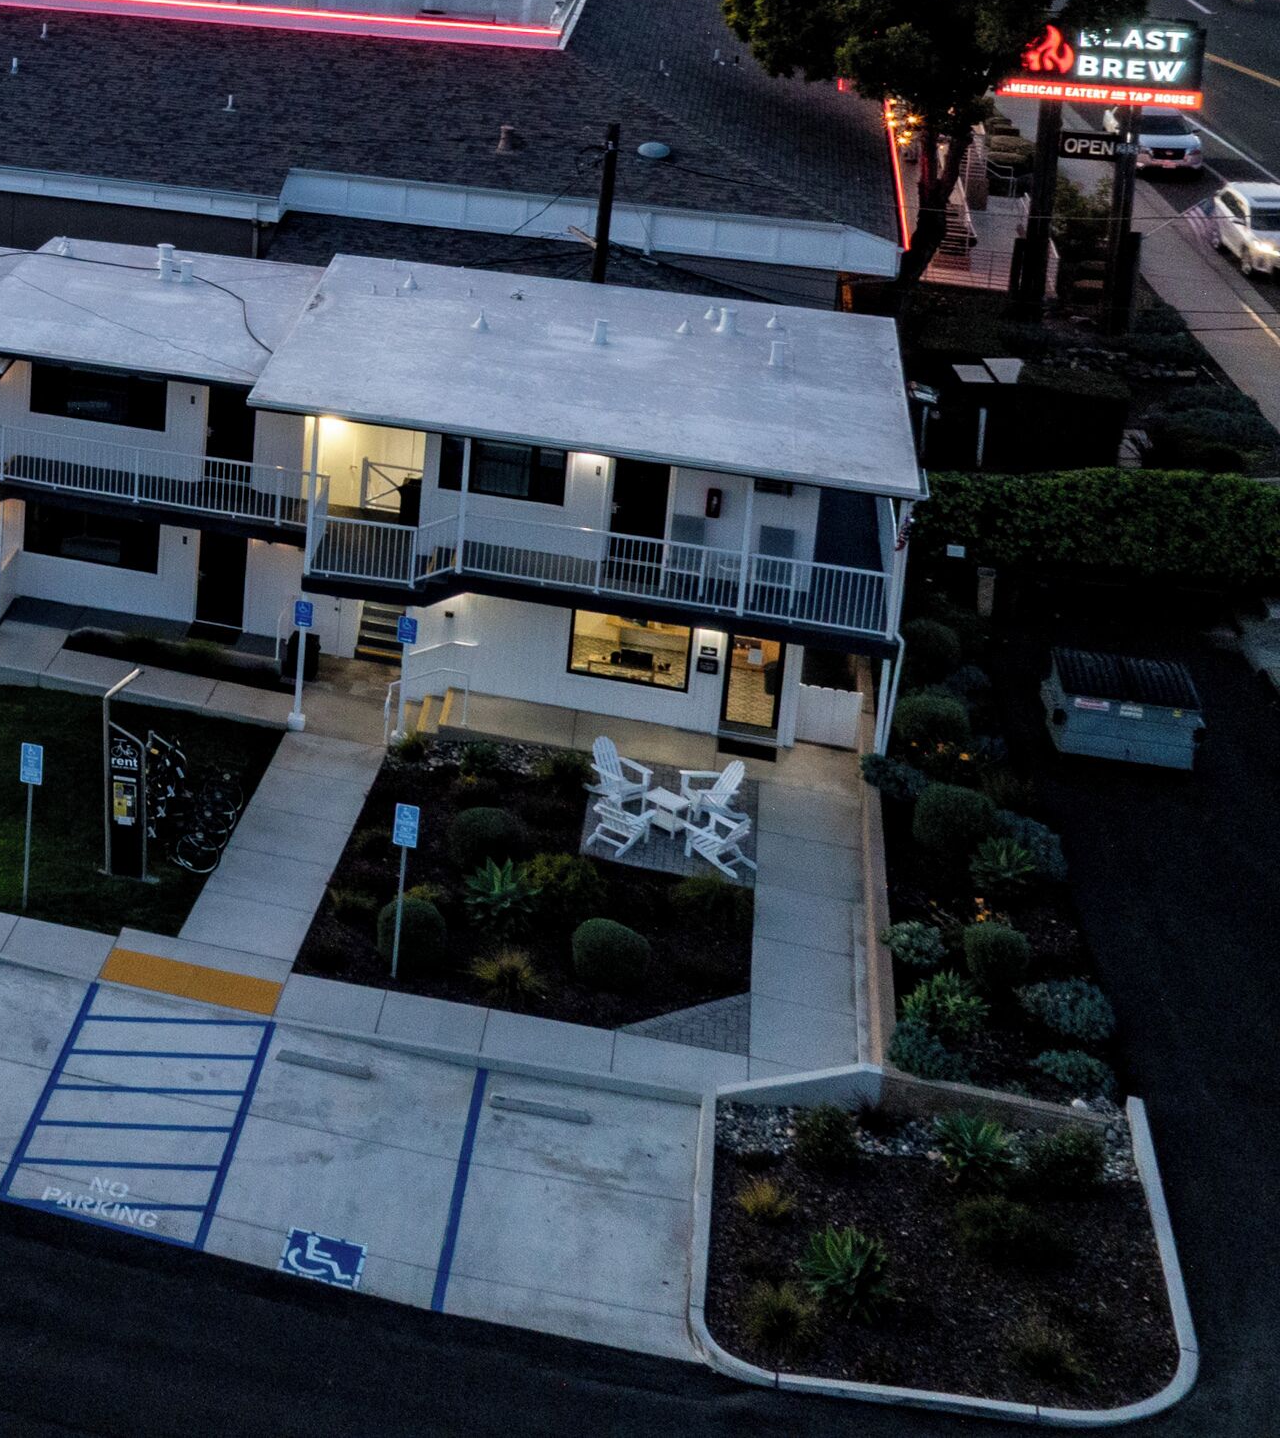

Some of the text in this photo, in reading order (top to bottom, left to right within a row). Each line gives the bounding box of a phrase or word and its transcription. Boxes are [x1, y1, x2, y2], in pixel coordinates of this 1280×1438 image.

[1076, 55, 1186, 82] BREW
[1065, 86, 1108, 100] EATERY
[1129, 92, 1153, 103] TAP
[1154, 94, 1195, 105] HOUSE
[1064, 138, 1114, 156] OPEN
[111, 757, 138, 768] rent
[89, 1176, 129, 1198] NO
[41, 1186, 158, 1228] PARKING
